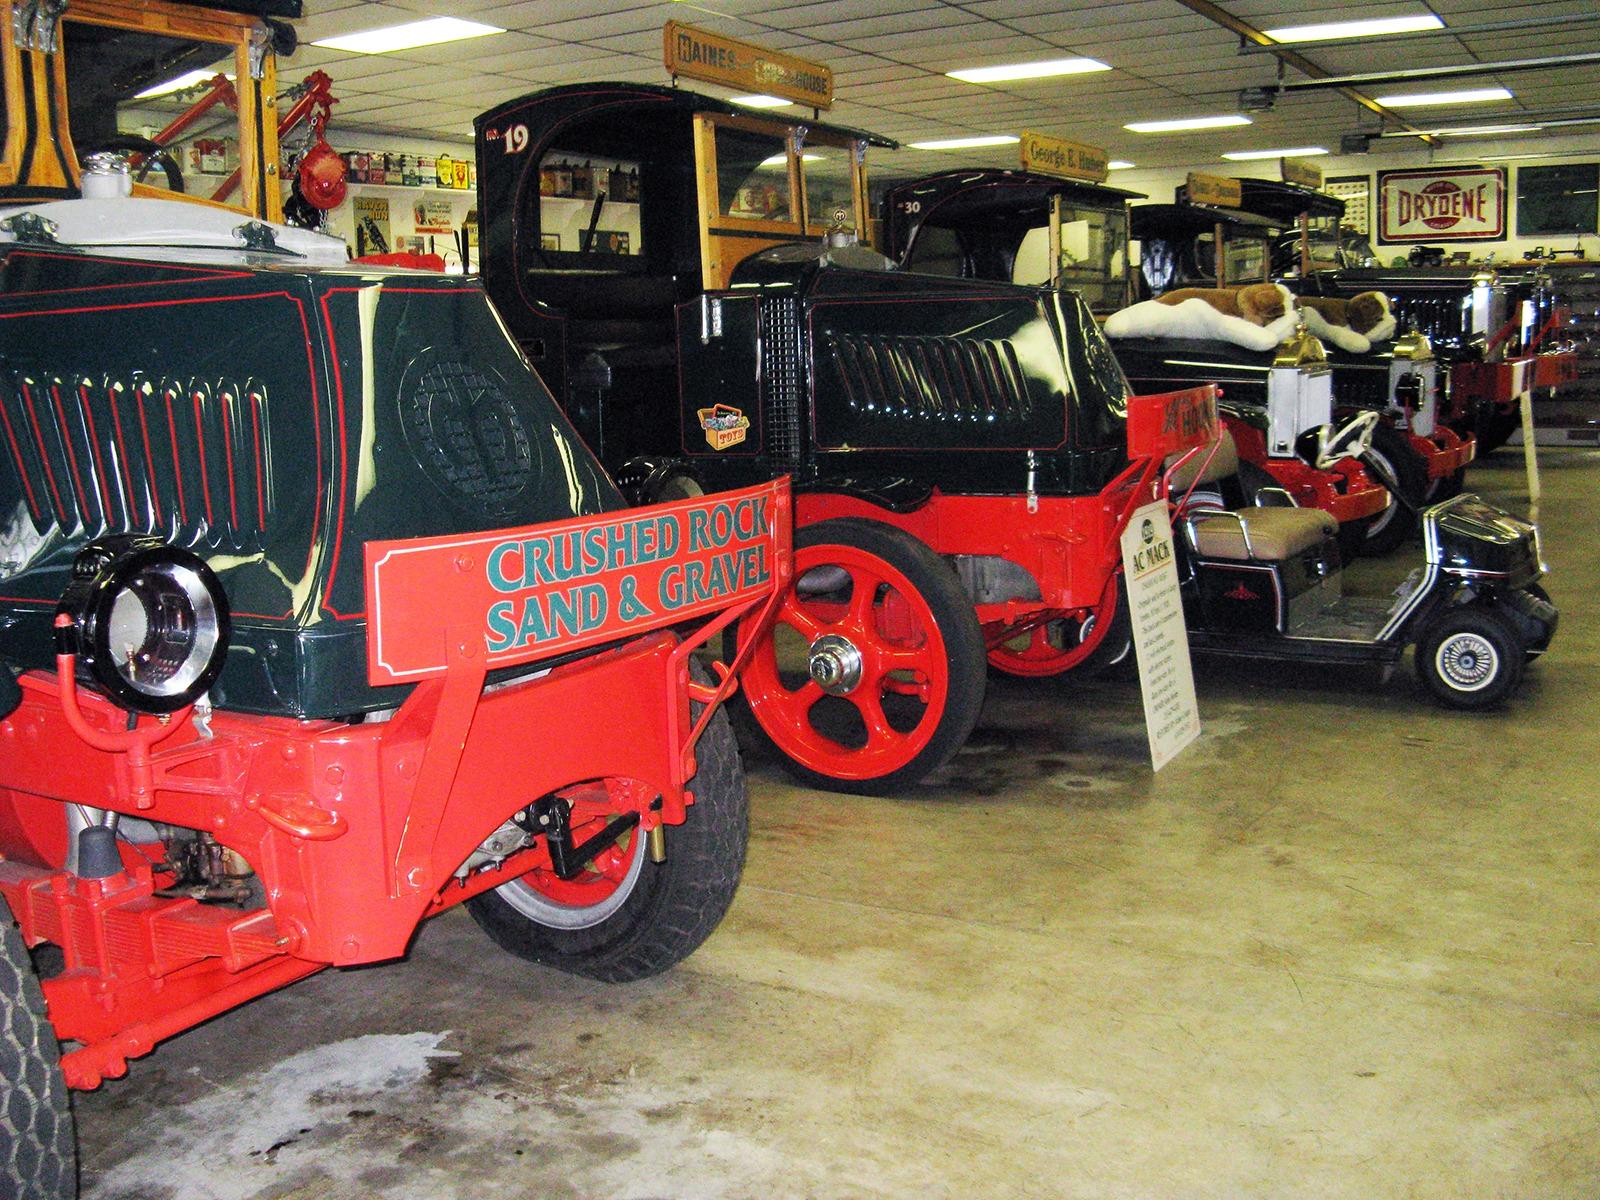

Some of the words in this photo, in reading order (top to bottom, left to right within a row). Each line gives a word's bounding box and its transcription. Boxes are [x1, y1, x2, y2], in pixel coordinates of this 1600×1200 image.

[504, 124, 529, 155] 19
[904, 201, 921, 214] 30
[1397, 184, 1487, 227] DRYDENE
[719, 429, 744, 445] TOYS
[486, 512, 680, 594] CRUSHED
[688, 495, 770, 552] ROCK
[1133, 552, 1145, 575] AC
[1146, 540, 1171, 566] MACK
[486, 585, 608, 653] SAND
[619, 575, 652, 622] &
[658, 543, 771, 611] GRAVEL
